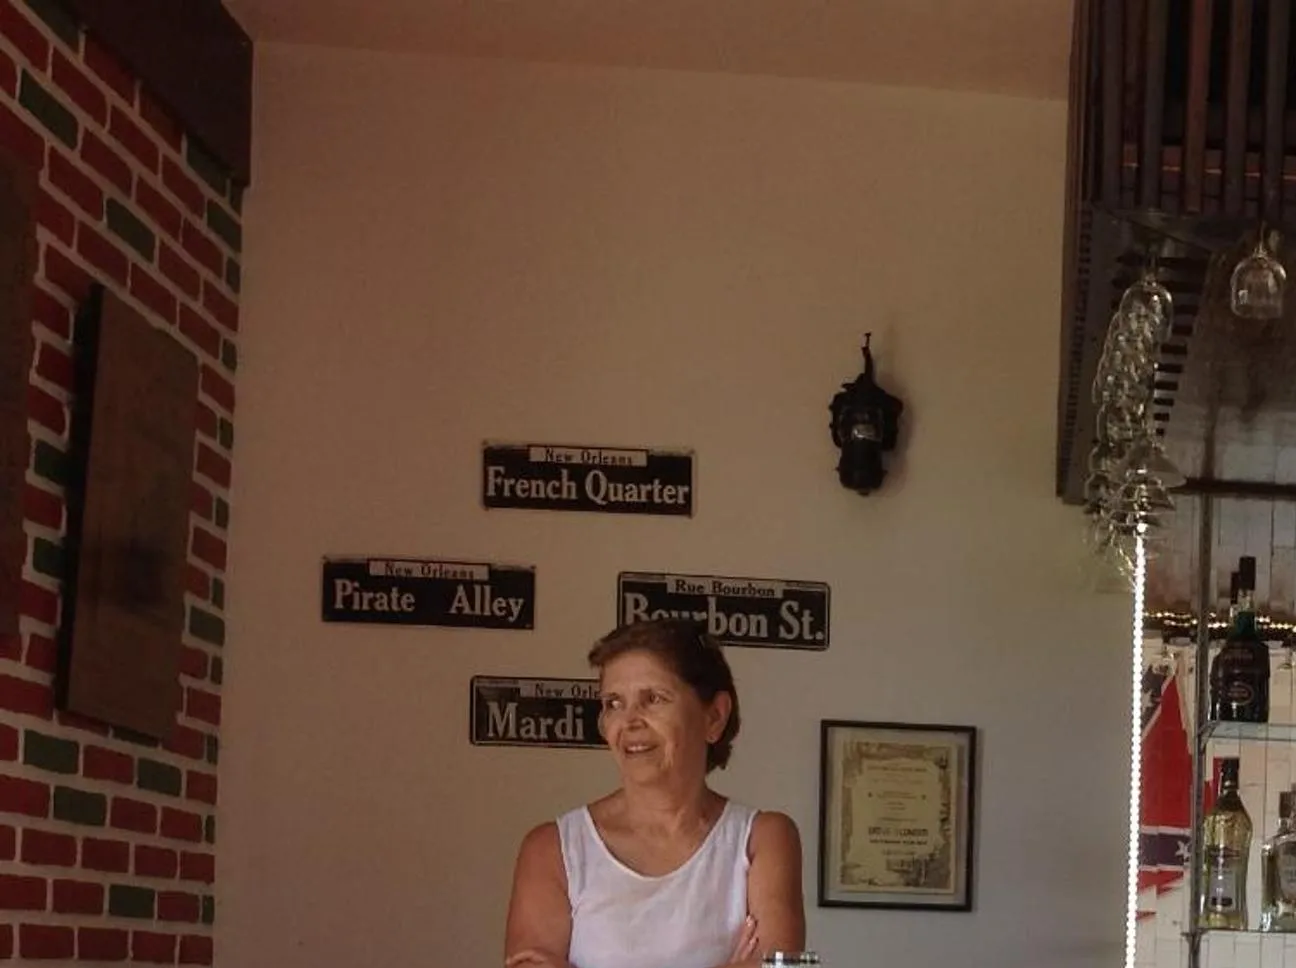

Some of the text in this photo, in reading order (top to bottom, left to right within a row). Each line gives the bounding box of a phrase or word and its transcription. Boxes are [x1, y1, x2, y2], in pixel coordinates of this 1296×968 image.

[544, 448, 633, 466] New Orleans
[486, 465, 690, 505] French Quarter
[384, 562, 475, 580] New Orleans
[334, 578, 525, 622] Pirate Alley
[675, 579, 776, 597] Rue Bourbon
[624, 591, 824, 640] Bbon St.
[535, 682, 564, 698] New
[487, 701, 585, 740] Mardi
